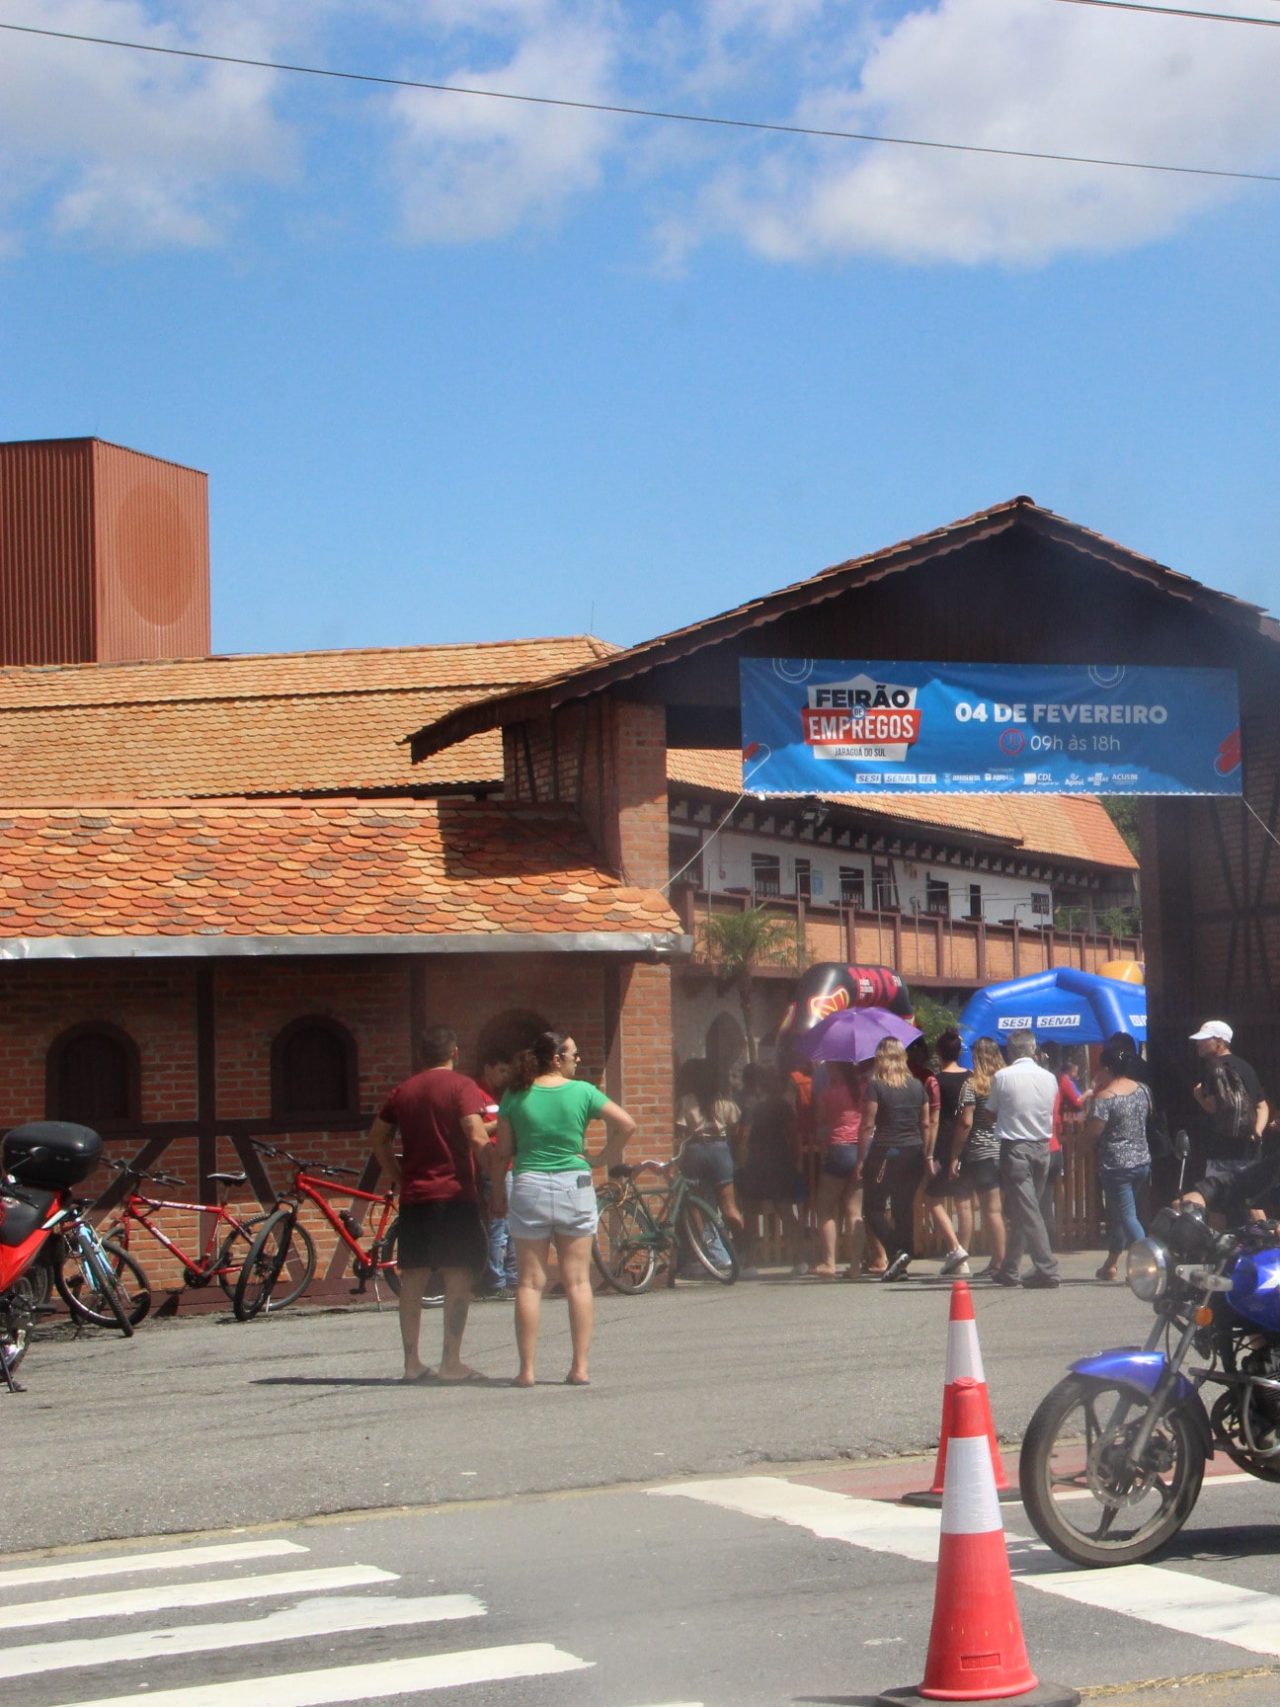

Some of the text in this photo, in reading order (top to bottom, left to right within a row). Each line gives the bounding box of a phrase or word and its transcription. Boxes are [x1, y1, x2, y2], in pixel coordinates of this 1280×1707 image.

[815, 684, 910, 709] FEIRÃO
[955, 702, 1169, 724] 04 DE FEVEREIRO
[808, 714, 915, 740] EMPREGOS
[1030, 735, 1121, 752] 09h às 18h
[874, 748, 887, 758] SUL
[858, 774, 880, 783] SESI
[885, 774, 916, 783] SENAI
[1001, 1015, 1077, 1028] SESI SENAI
